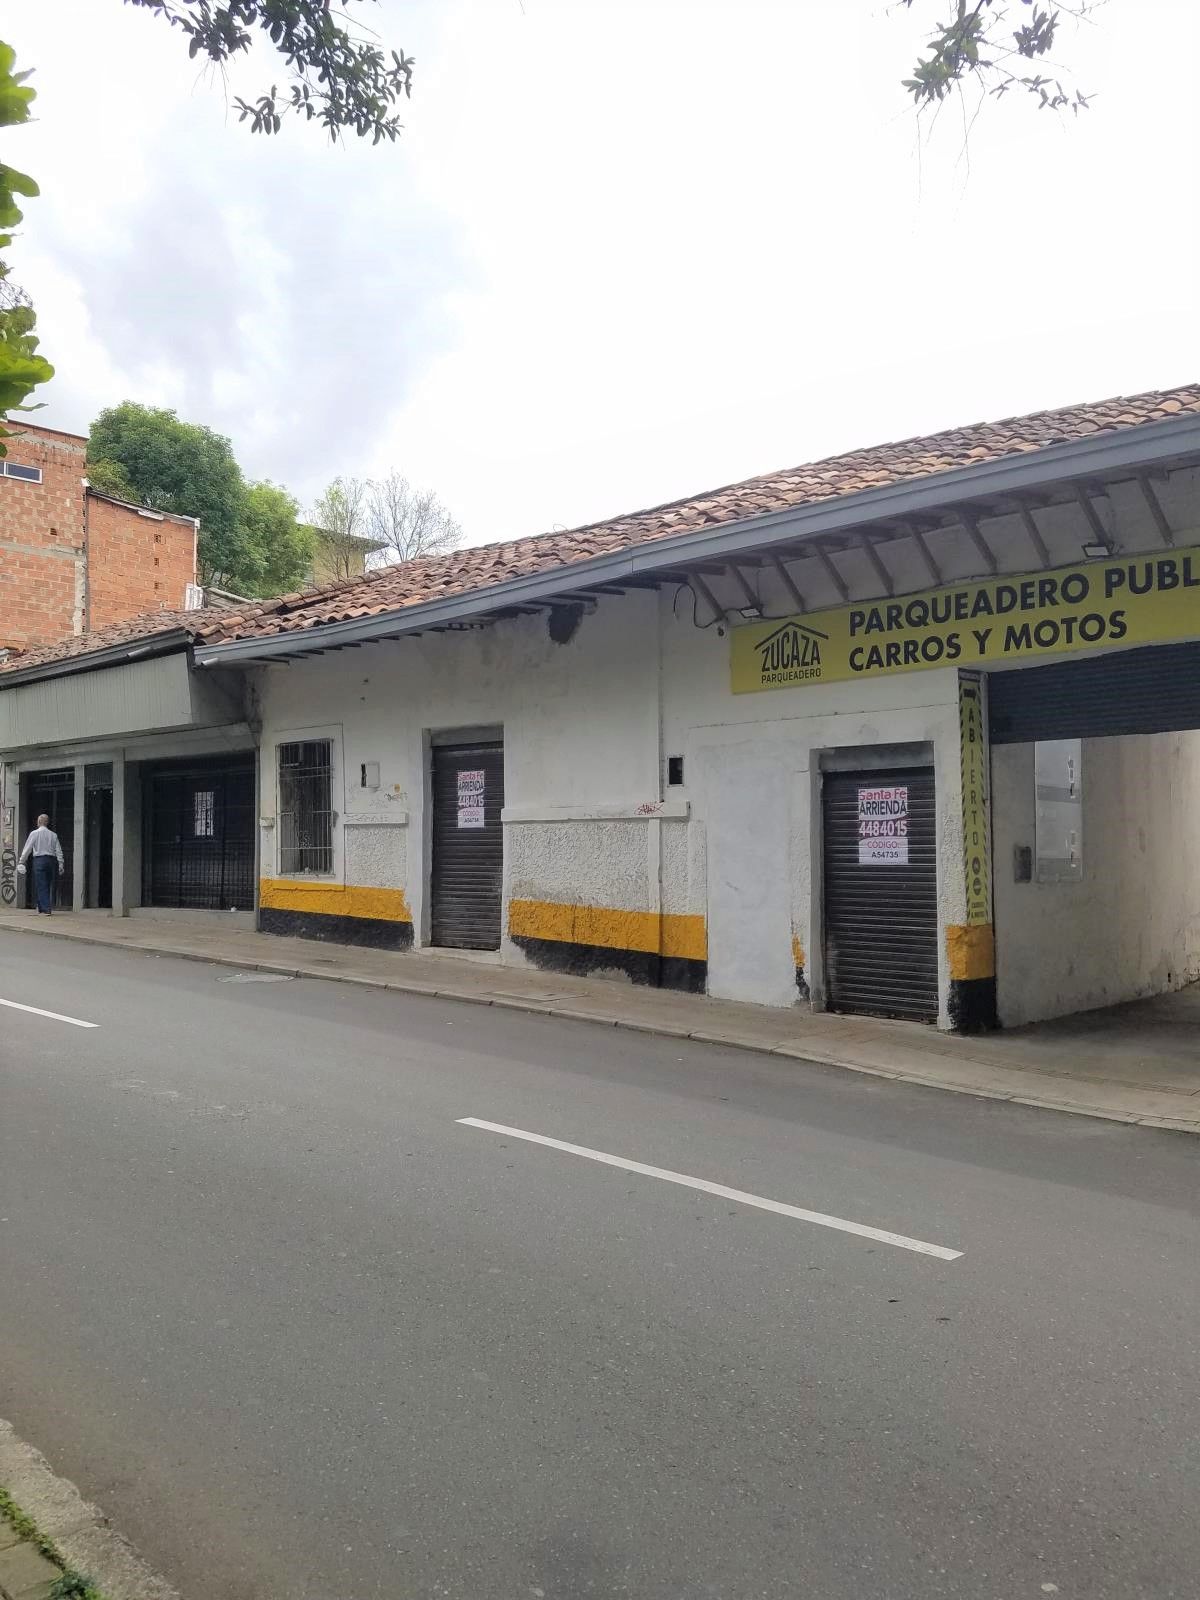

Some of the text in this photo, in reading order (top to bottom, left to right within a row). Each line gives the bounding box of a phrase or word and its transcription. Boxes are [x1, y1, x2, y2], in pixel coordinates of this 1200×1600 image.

[849, 556, 1200, 637] PARQUEADERO PUBL
[761, 630, 821, 673] ZUCAZA
[848, 610, 1128, 672] CARROS Y MOTOS
[761, 667, 822, 684] PARQUEADERO
[968, 707, 979, 846] ABIERTO
[859, 788, 906, 801] Santa Fe
[859, 800, 907, 815] ARRIENDA
[859, 820, 907, 836] 4484015
